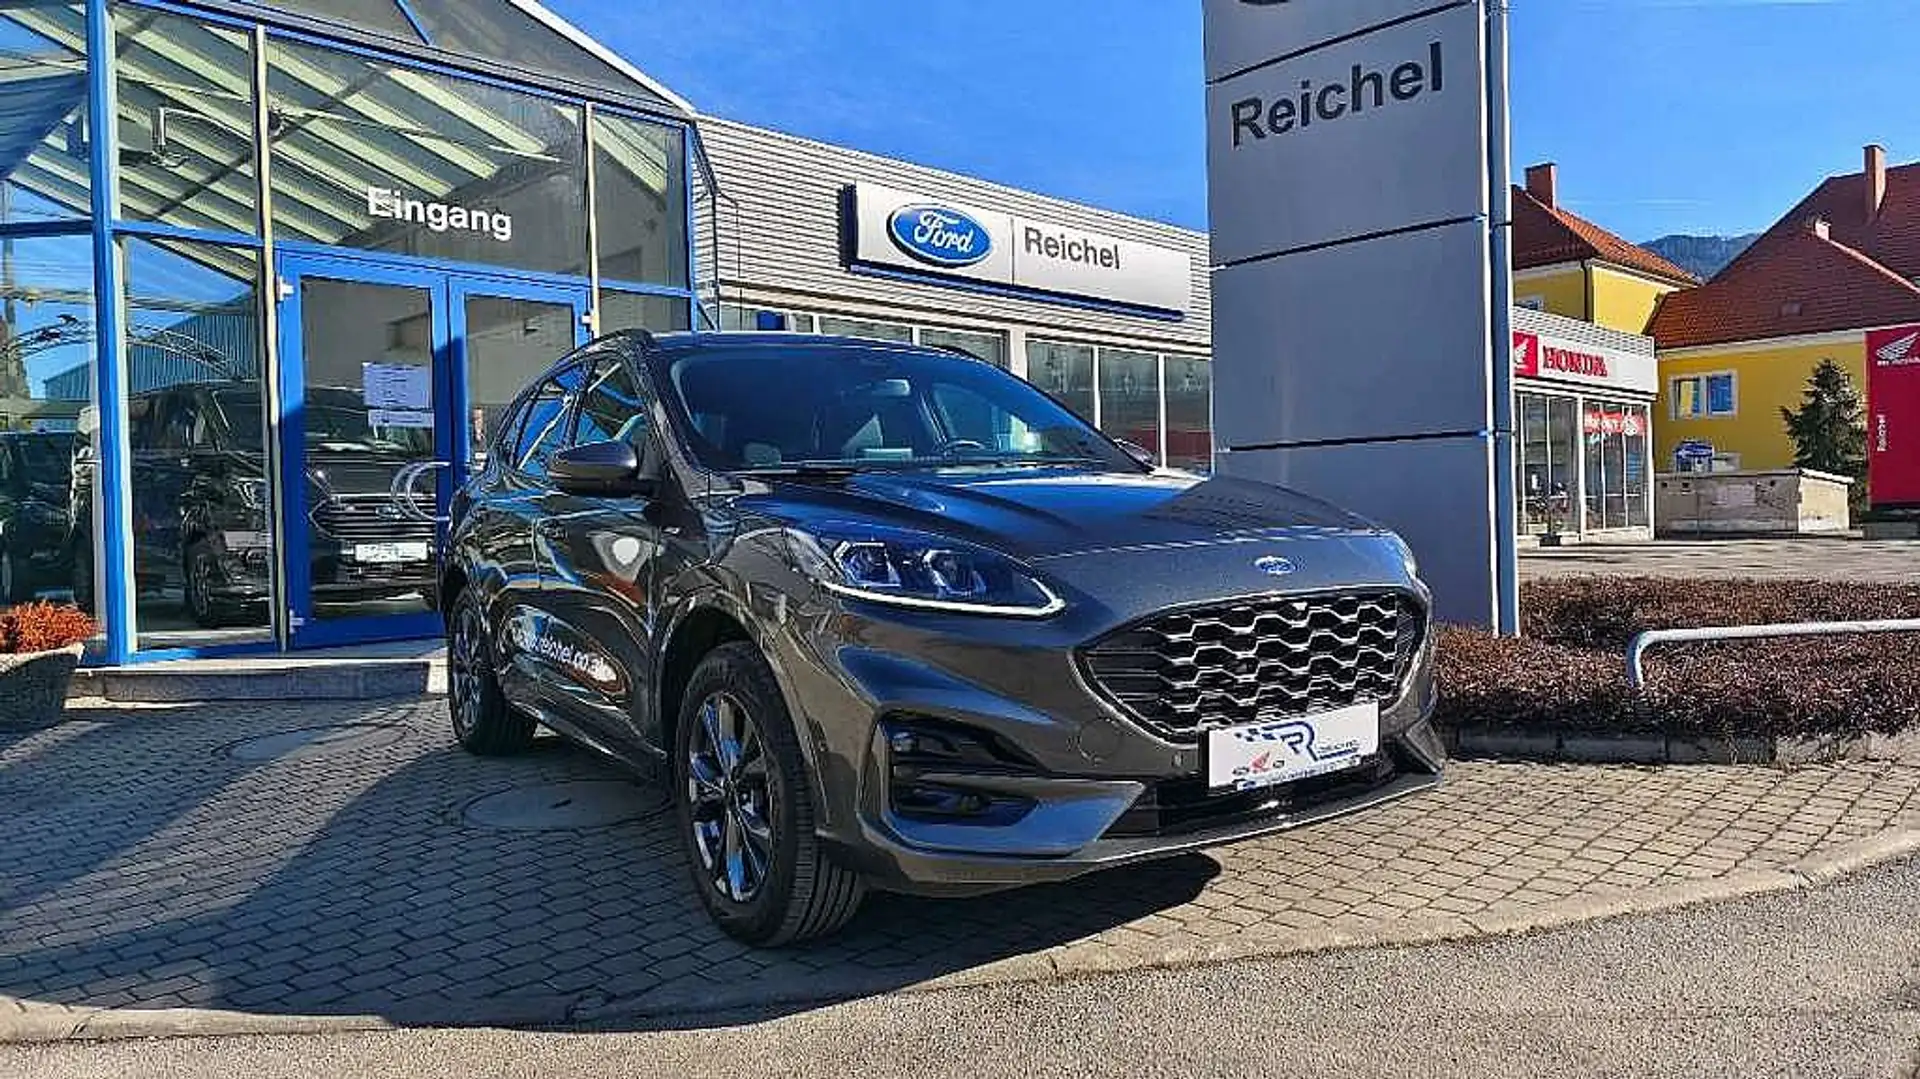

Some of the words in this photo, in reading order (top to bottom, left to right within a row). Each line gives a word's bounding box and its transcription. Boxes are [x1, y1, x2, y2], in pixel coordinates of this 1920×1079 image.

[1231, 41, 1443, 147] Reichel
[368, 186, 512, 241] Eingang
[914, 210, 975, 253] Ford
[1024, 226, 1121, 269] Reichel
[1543, 345, 1608, 377] HONDA
